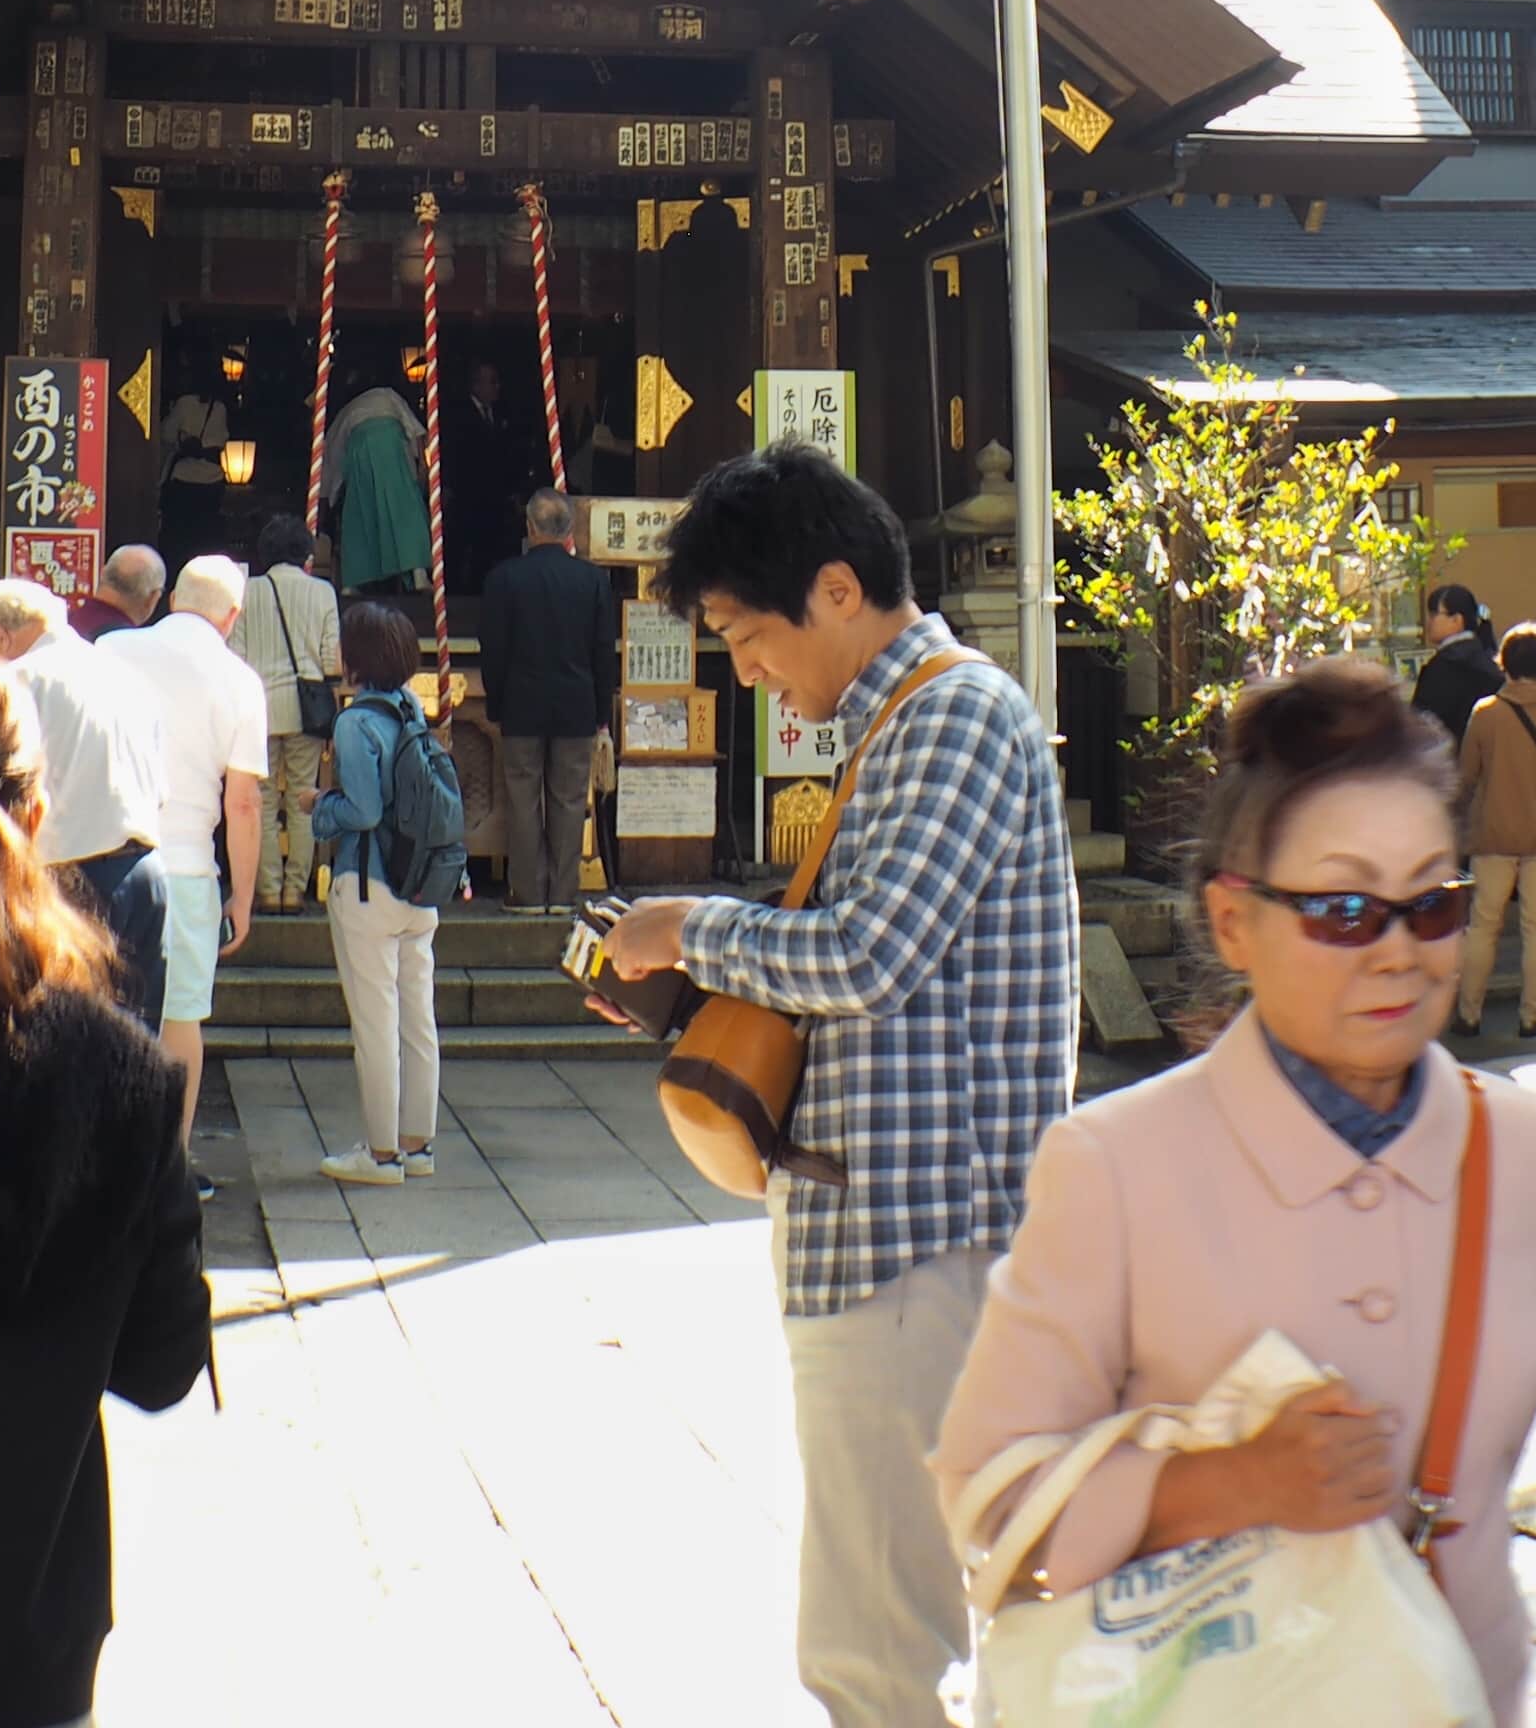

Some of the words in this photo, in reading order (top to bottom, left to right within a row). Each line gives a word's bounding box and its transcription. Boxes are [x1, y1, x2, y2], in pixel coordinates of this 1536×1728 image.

[6, 368, 63, 527] 酉の市
[607, 511, 627, 550] 開運
[696, 702, 708, 745] おみくじ
